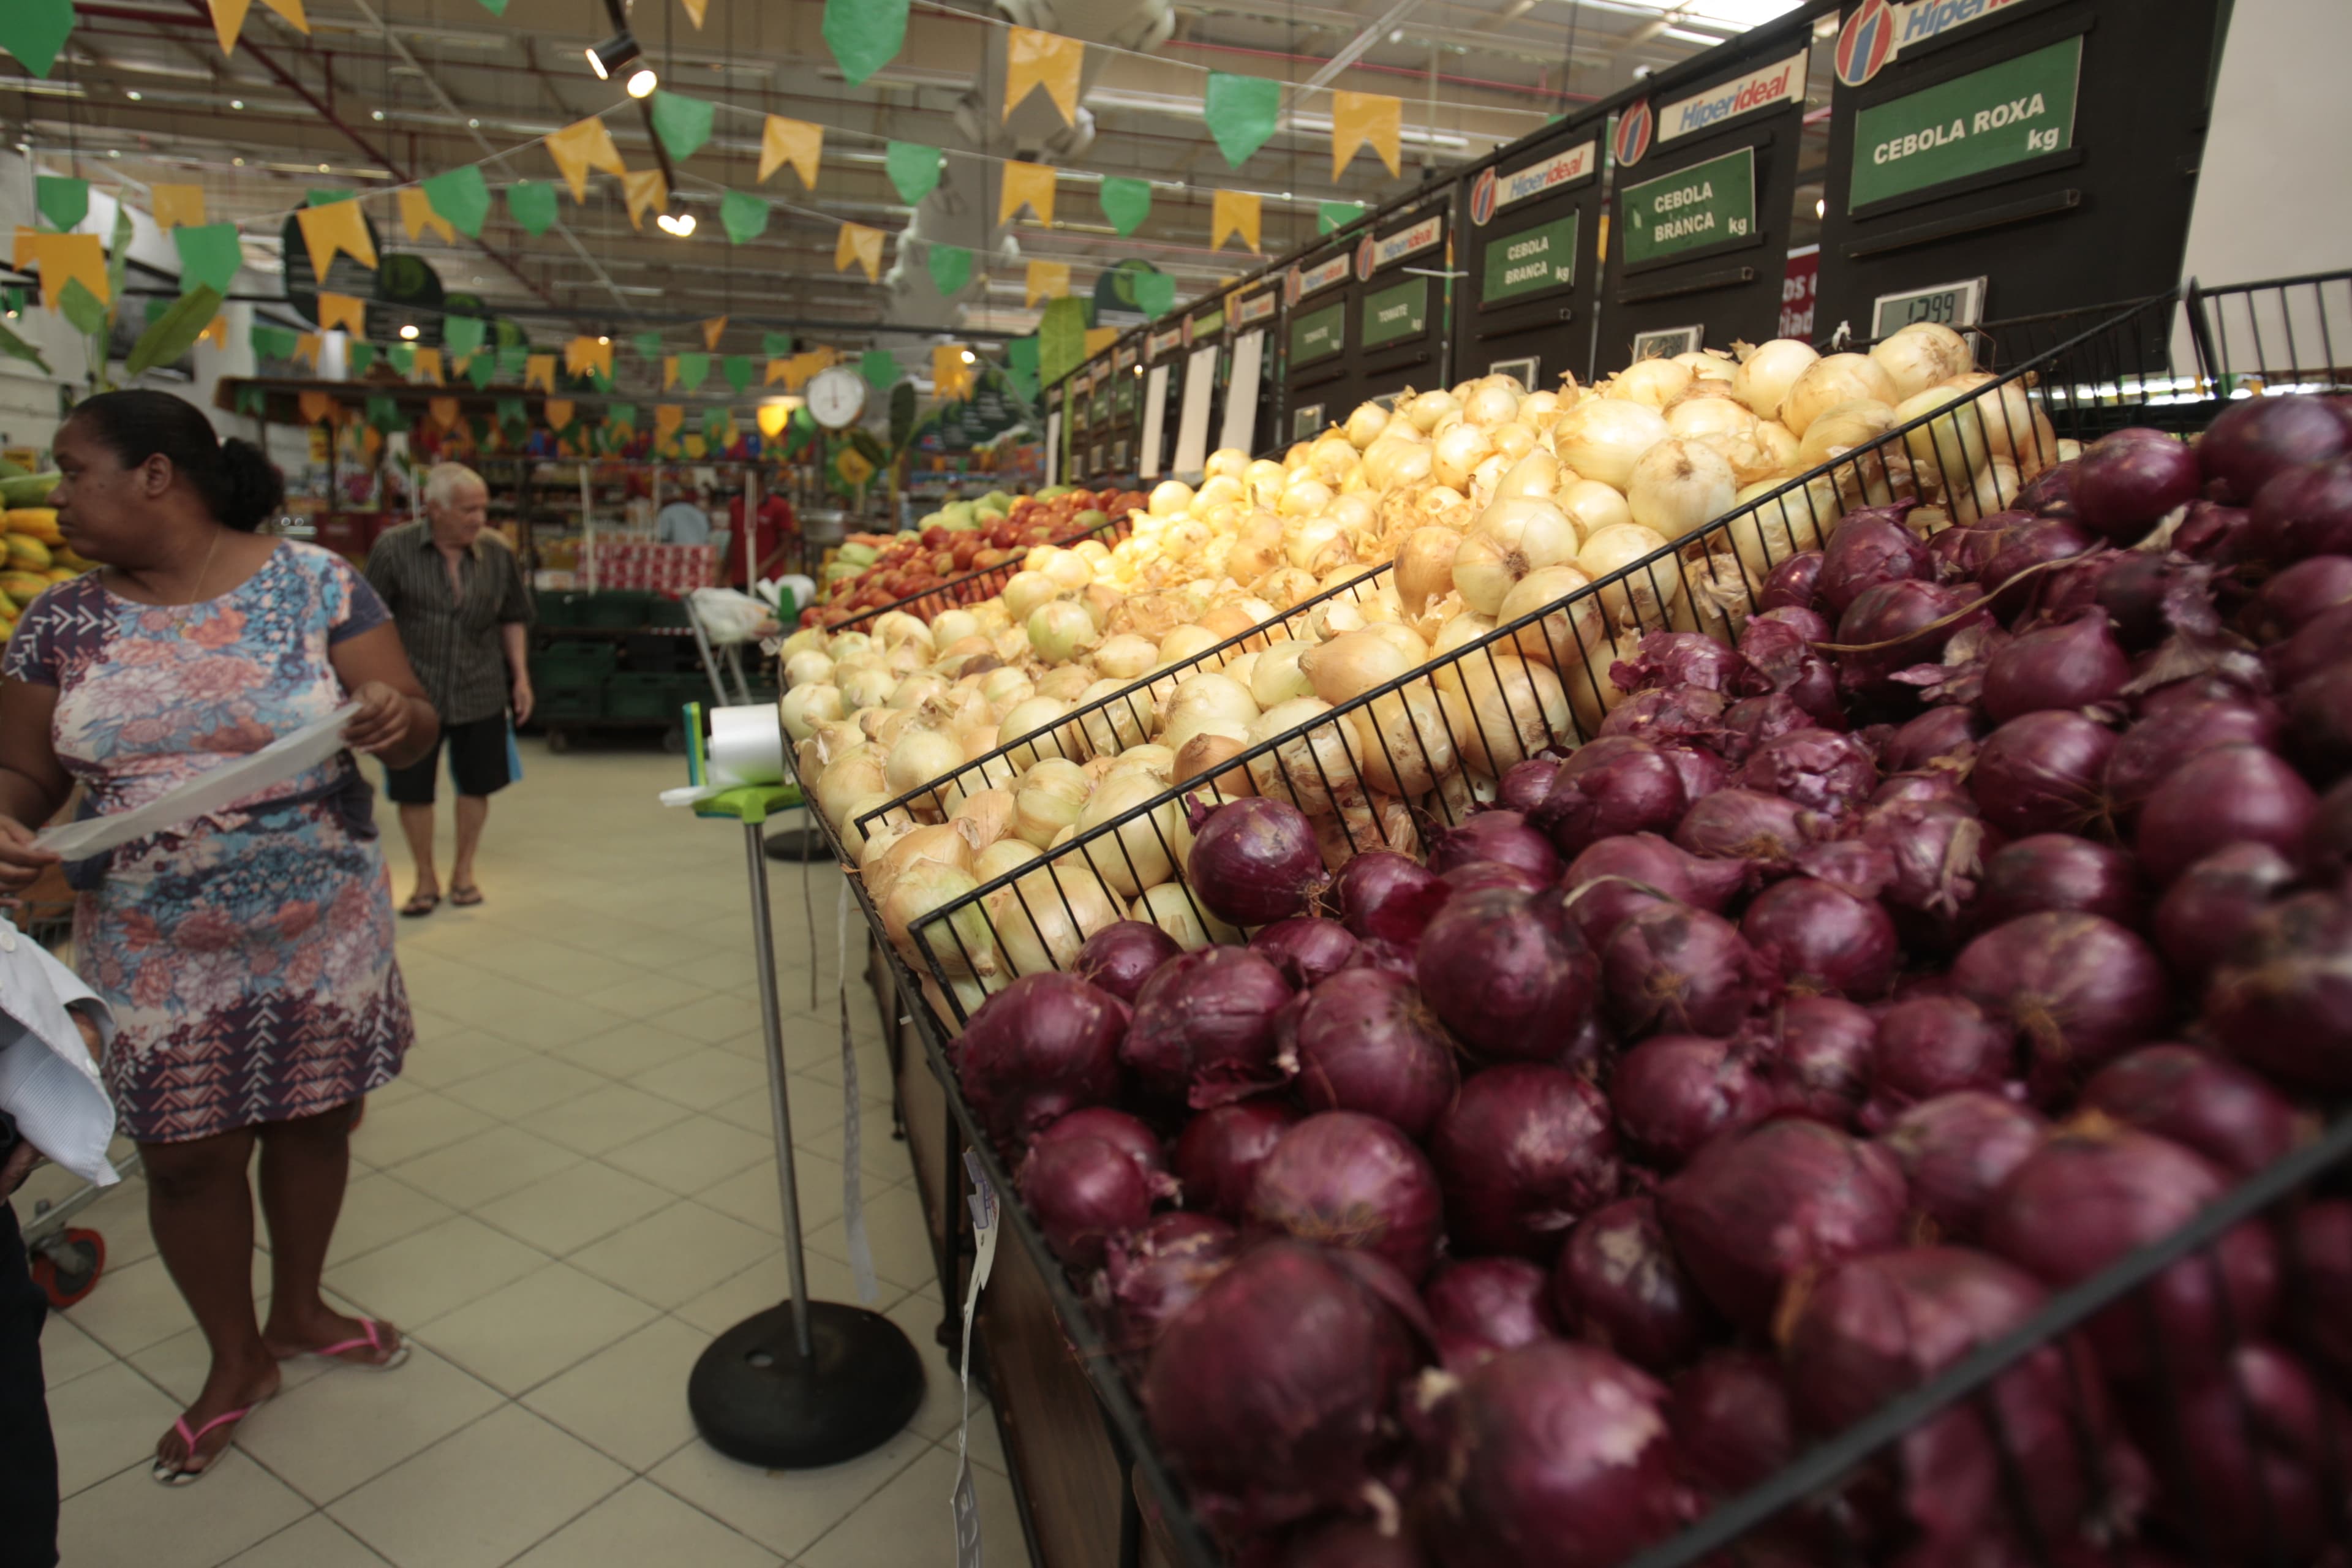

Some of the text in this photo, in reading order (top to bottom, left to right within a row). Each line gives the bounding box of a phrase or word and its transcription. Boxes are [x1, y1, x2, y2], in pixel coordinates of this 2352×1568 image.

[1679, 65, 1791, 132] Hiperideal
[1873, 92, 2045, 165] CEBOLA ROXA
[2027, 127, 2059, 151] kg
[1510, 151, 1585, 200] Hiperideal
[1654, 181, 1713, 213] CEBOLA
[1654, 211, 1747, 242] BRANCA kg
[1508, 235, 1549, 261] CEBOLA
[1505, 260, 1569, 285] BRANCA kg
